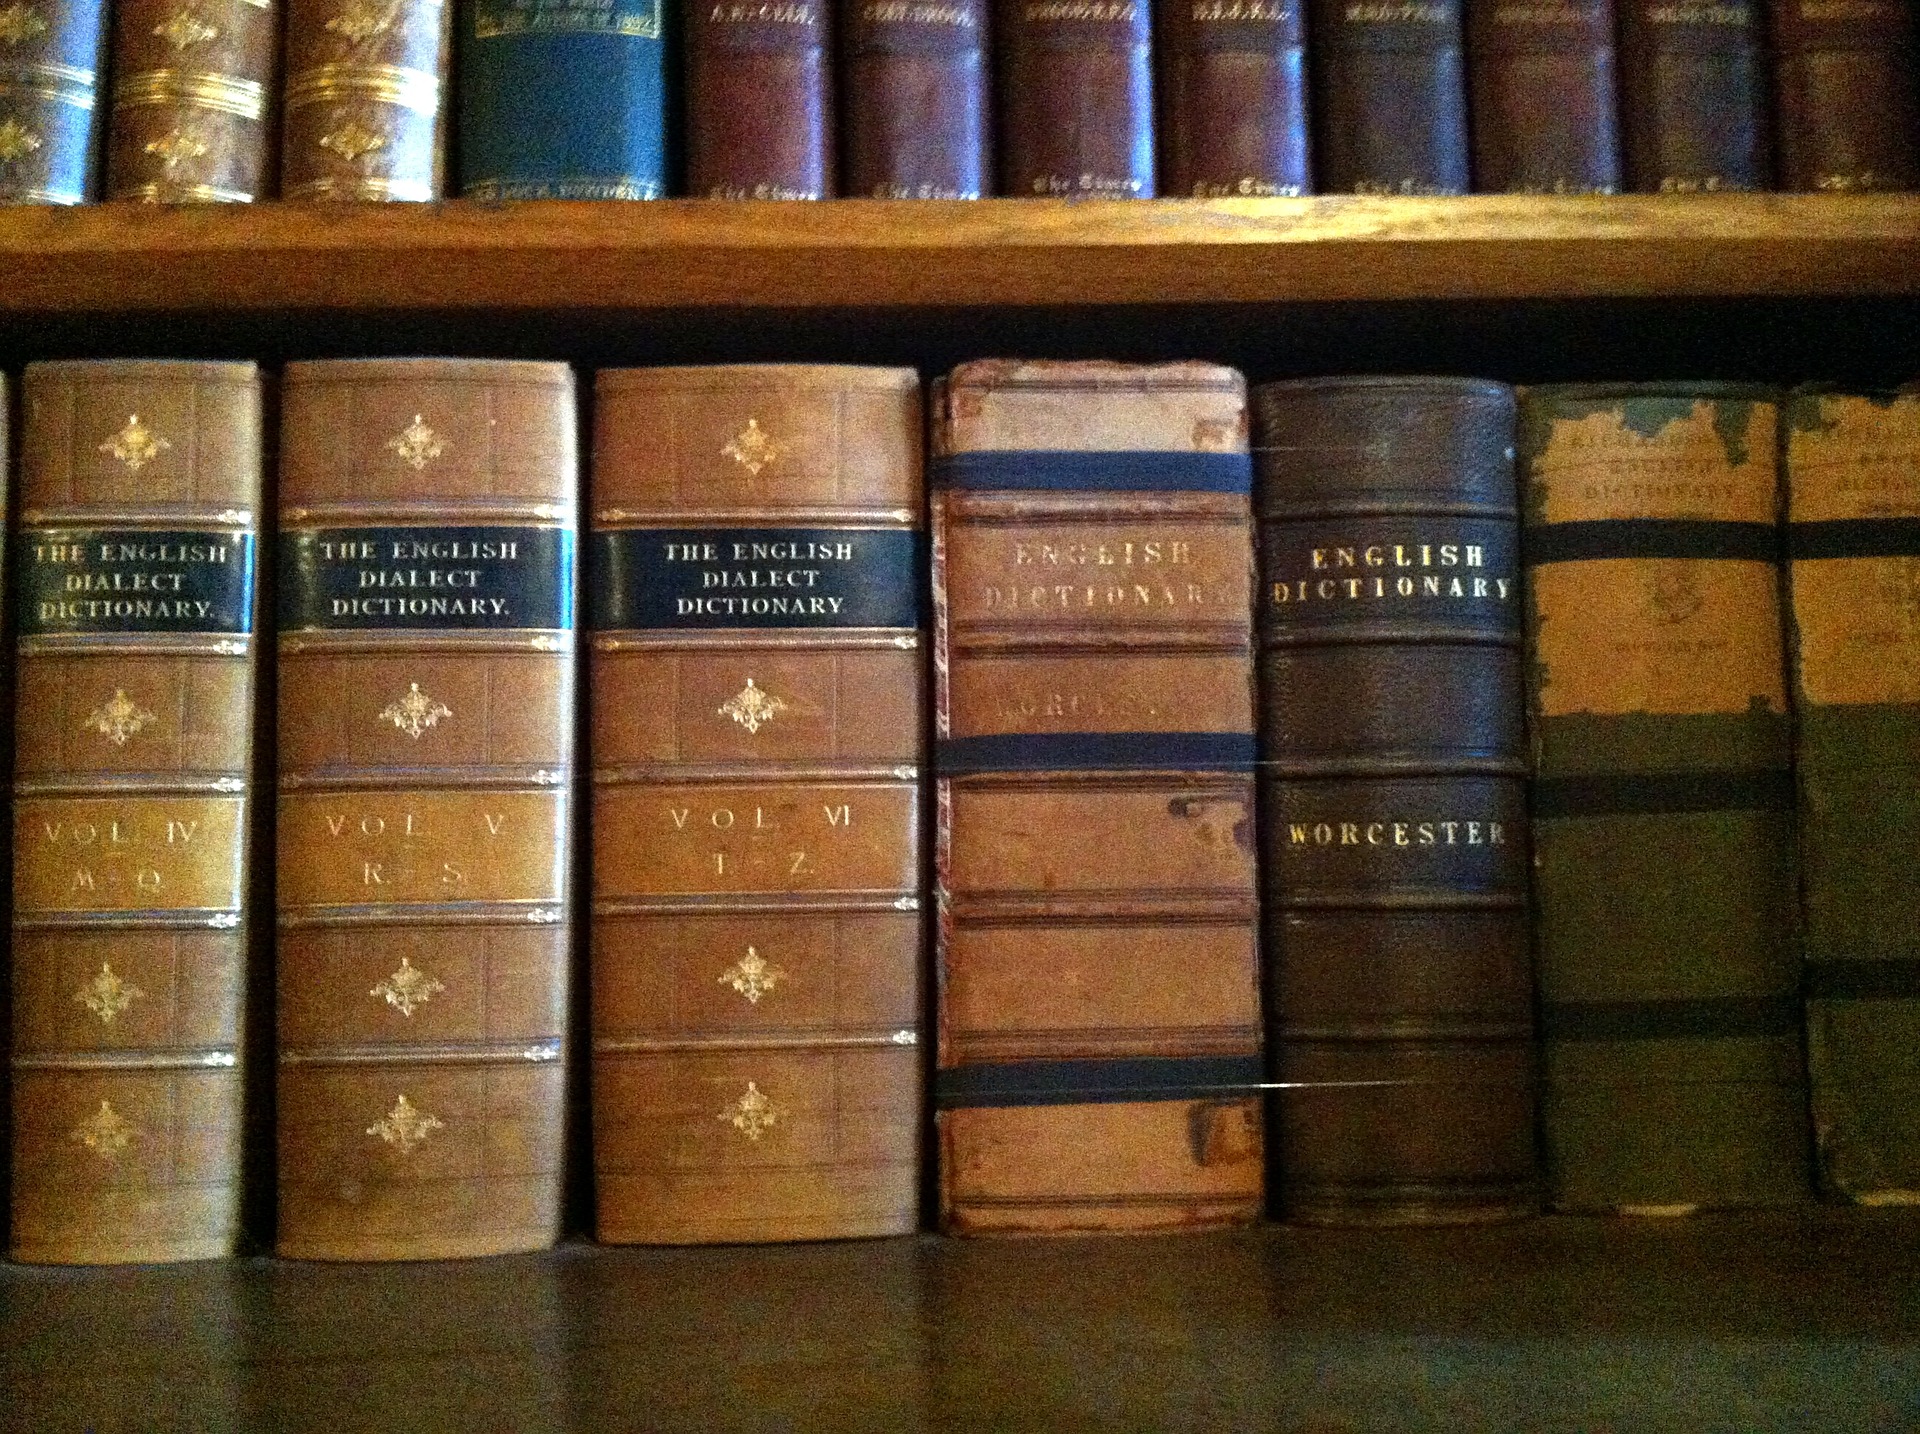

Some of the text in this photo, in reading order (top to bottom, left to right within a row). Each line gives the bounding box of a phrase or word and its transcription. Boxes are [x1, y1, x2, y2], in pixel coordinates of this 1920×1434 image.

[33, 543, 227, 563] THE ENGLISH
[319, 541, 518, 560] THE ENGLISH
[664, 542, 853, 562] THE ENGLISH
[1016, 541, 1191, 566] ENGLISH
[1312, 544, 1484, 569] ENGLISH
[66, 572, 187, 592] DIALECT
[358, 569, 482, 588] DIALECT
[702, 569, 820, 589] DIALECT
[1272, 575, 1511, 602] DICTIONARY
[332, 598, 511, 616] DICTIONARY.
[483, 813, 504, 835] V
[823, 803, 850, 827] VI
[1287, 820, 1505, 846] WORCESTER
